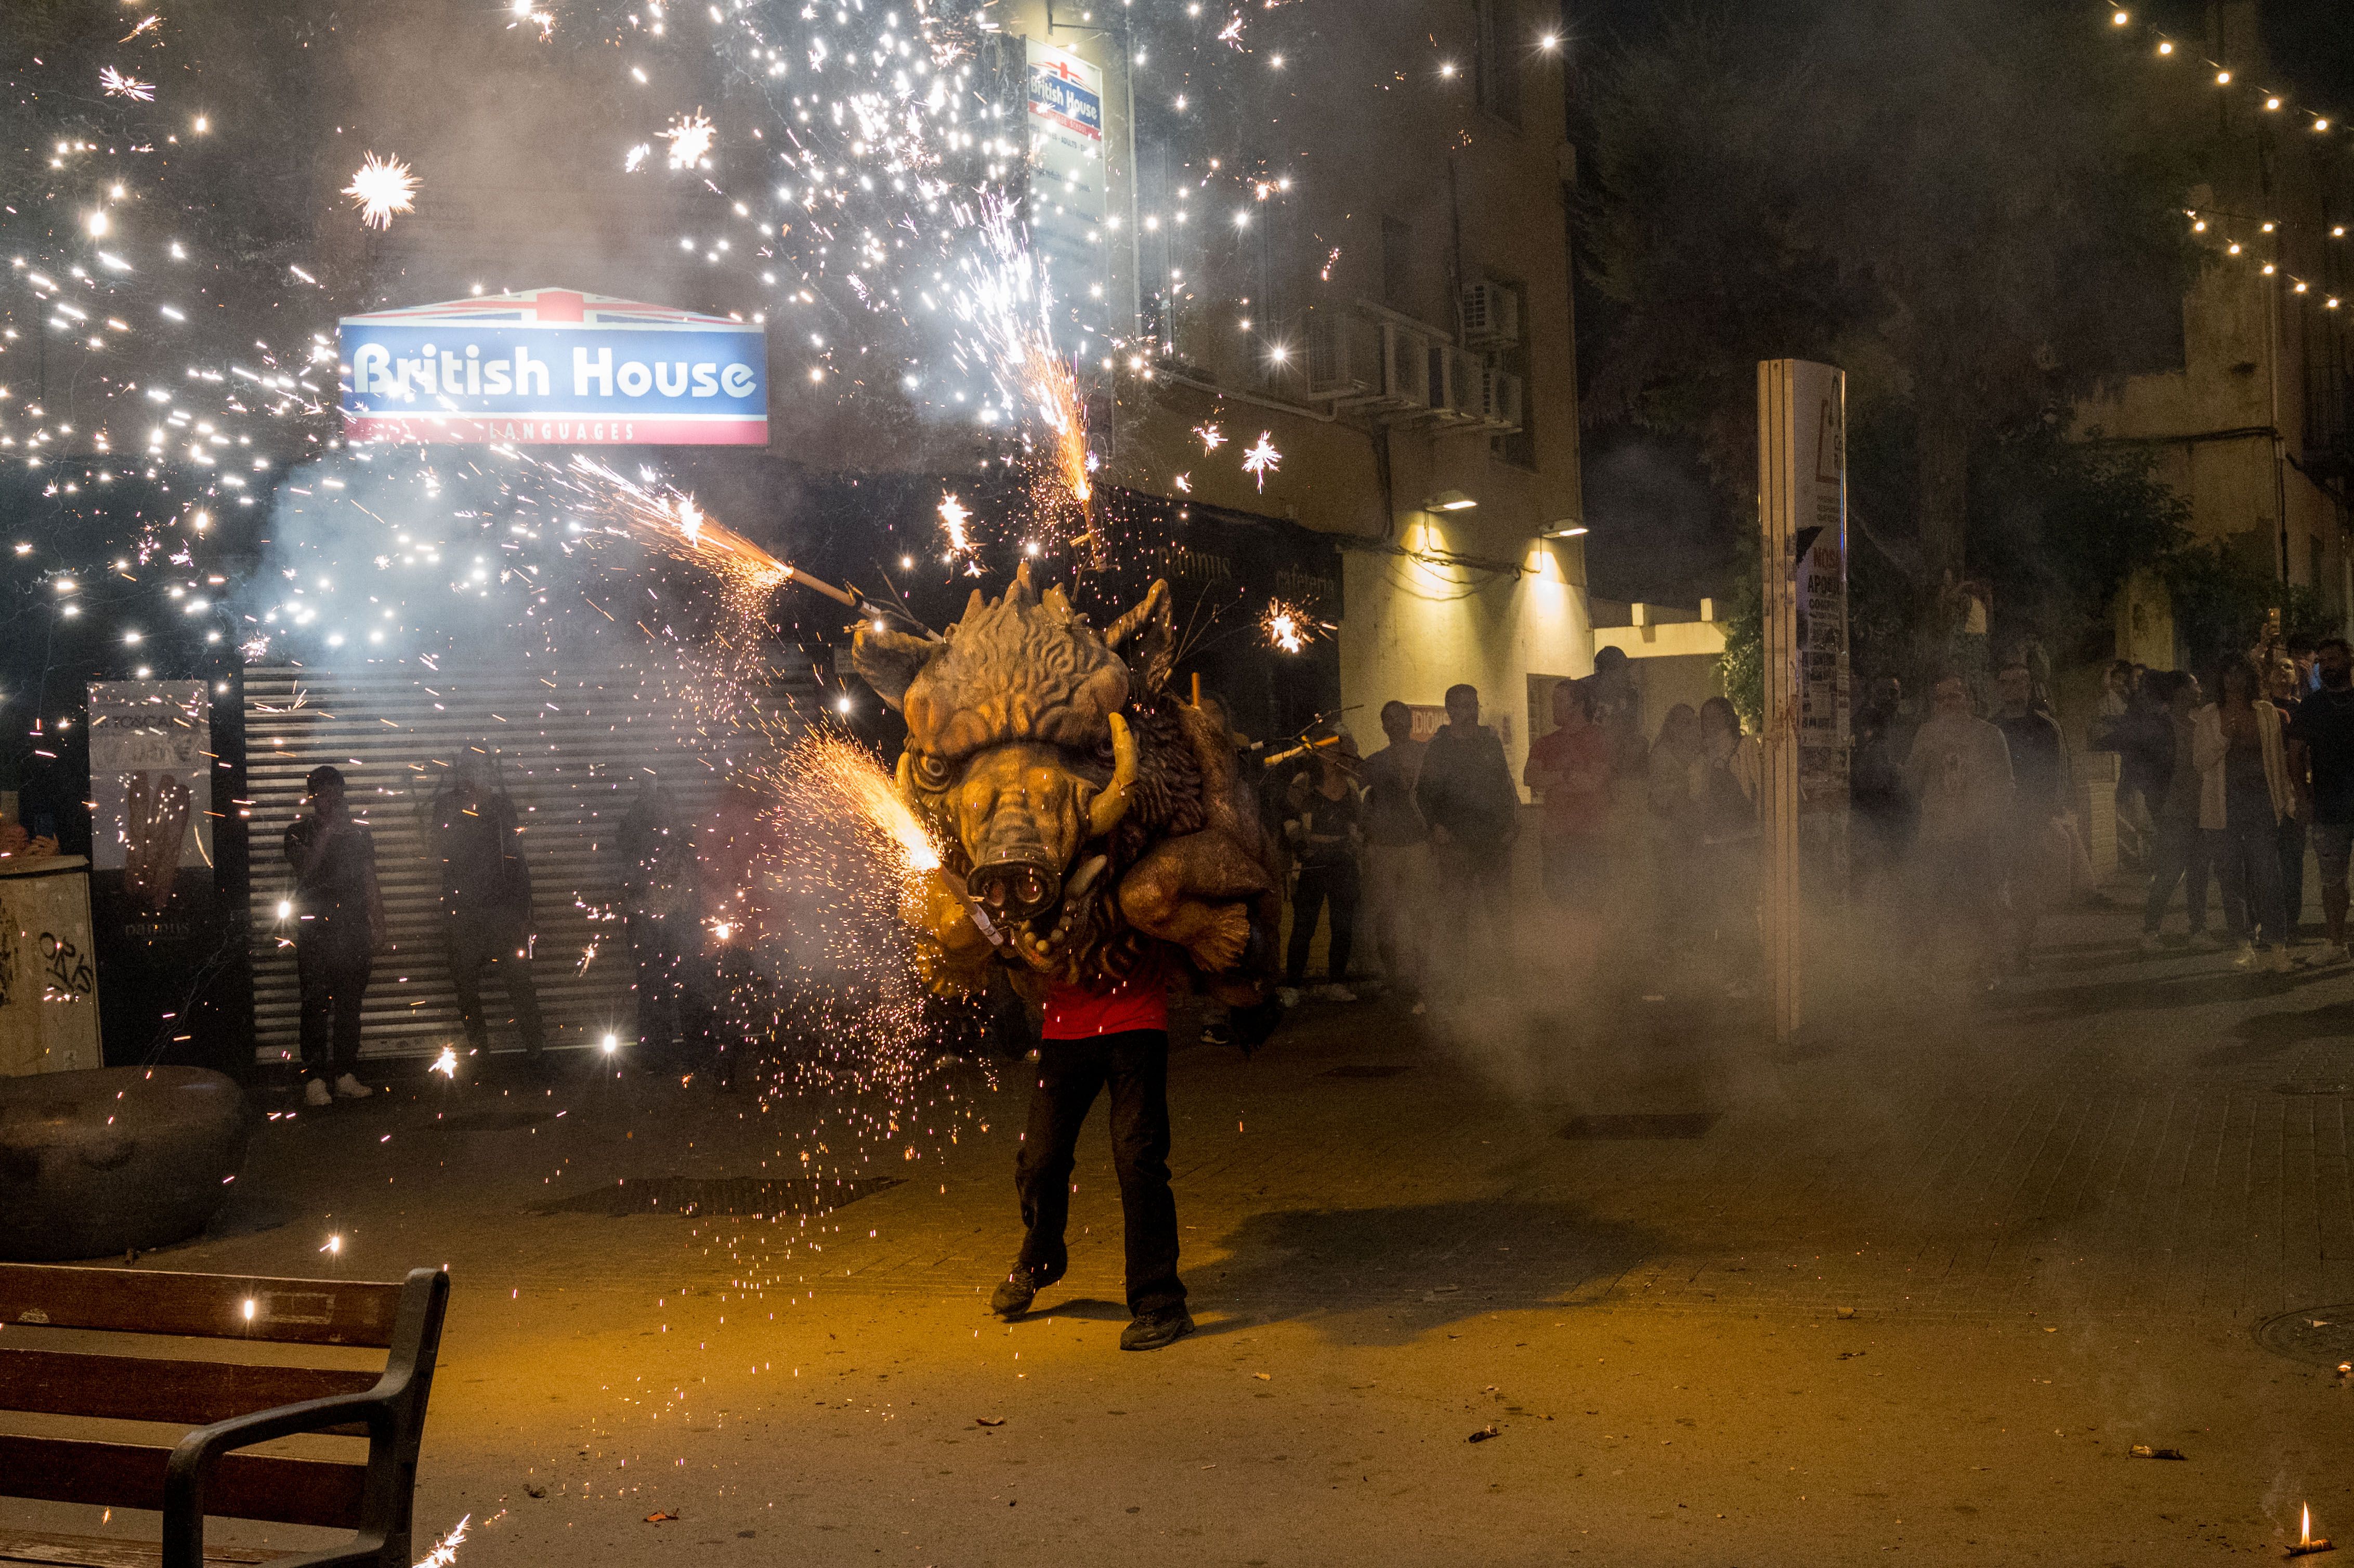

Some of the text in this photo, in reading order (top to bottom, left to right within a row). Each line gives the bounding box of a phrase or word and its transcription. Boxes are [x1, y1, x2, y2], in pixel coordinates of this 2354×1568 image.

[1030, 75, 1097, 120] British House
[1061, 136, 1077, 149] ADULTS
[354, 343, 757, 398] British House
[489, 422, 634, 441] LANGUAGES
[1157, 545, 1232, 581] pannus
[1276, 563, 1335, 596] cafeteria
